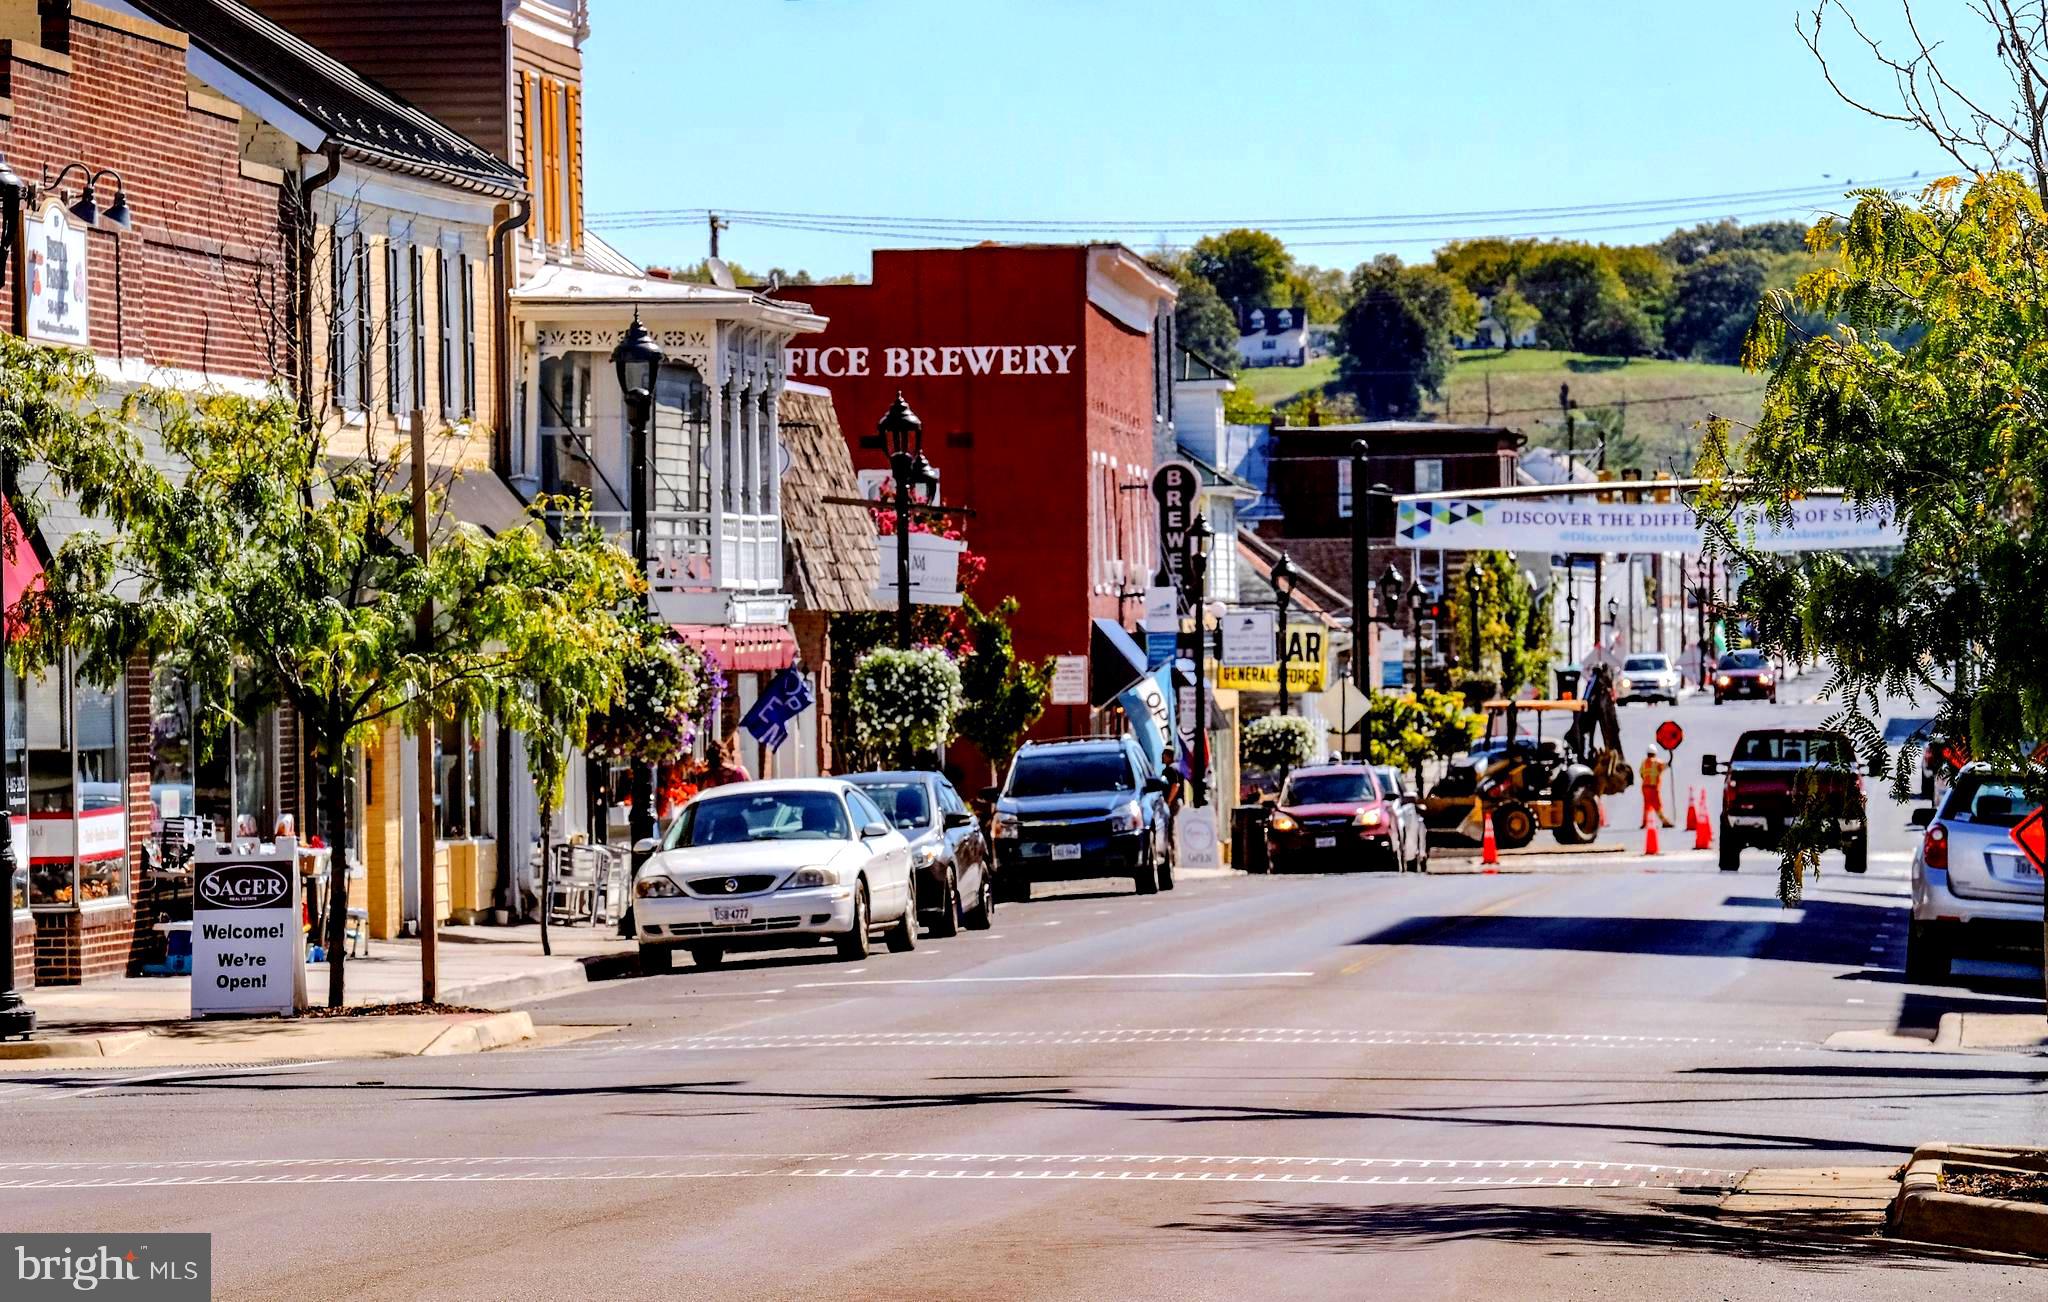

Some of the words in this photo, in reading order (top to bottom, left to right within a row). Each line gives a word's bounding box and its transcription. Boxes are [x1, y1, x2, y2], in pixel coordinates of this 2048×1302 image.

[884, 345, 1076, 377] BREWERY
[1502, 511, 1593, 526] DISCOVER
[1598, 513, 1635, 527] THE
[1641, 512, 1745, 527] DIFFET
[1805, 508, 1828, 523] OF
[1167, 470, 1184, 592] BREWER
[1276, 631, 1321, 663] AR
[1223, 666, 1272, 683] GENERAL
[1277, 668, 1321, 687] ORES
[205, 875, 282, 897] SAGER
[202, 922, 284, 940] Welcome!
[217, 952, 267, 967] We're
[216, 974, 267, 992] Open!
